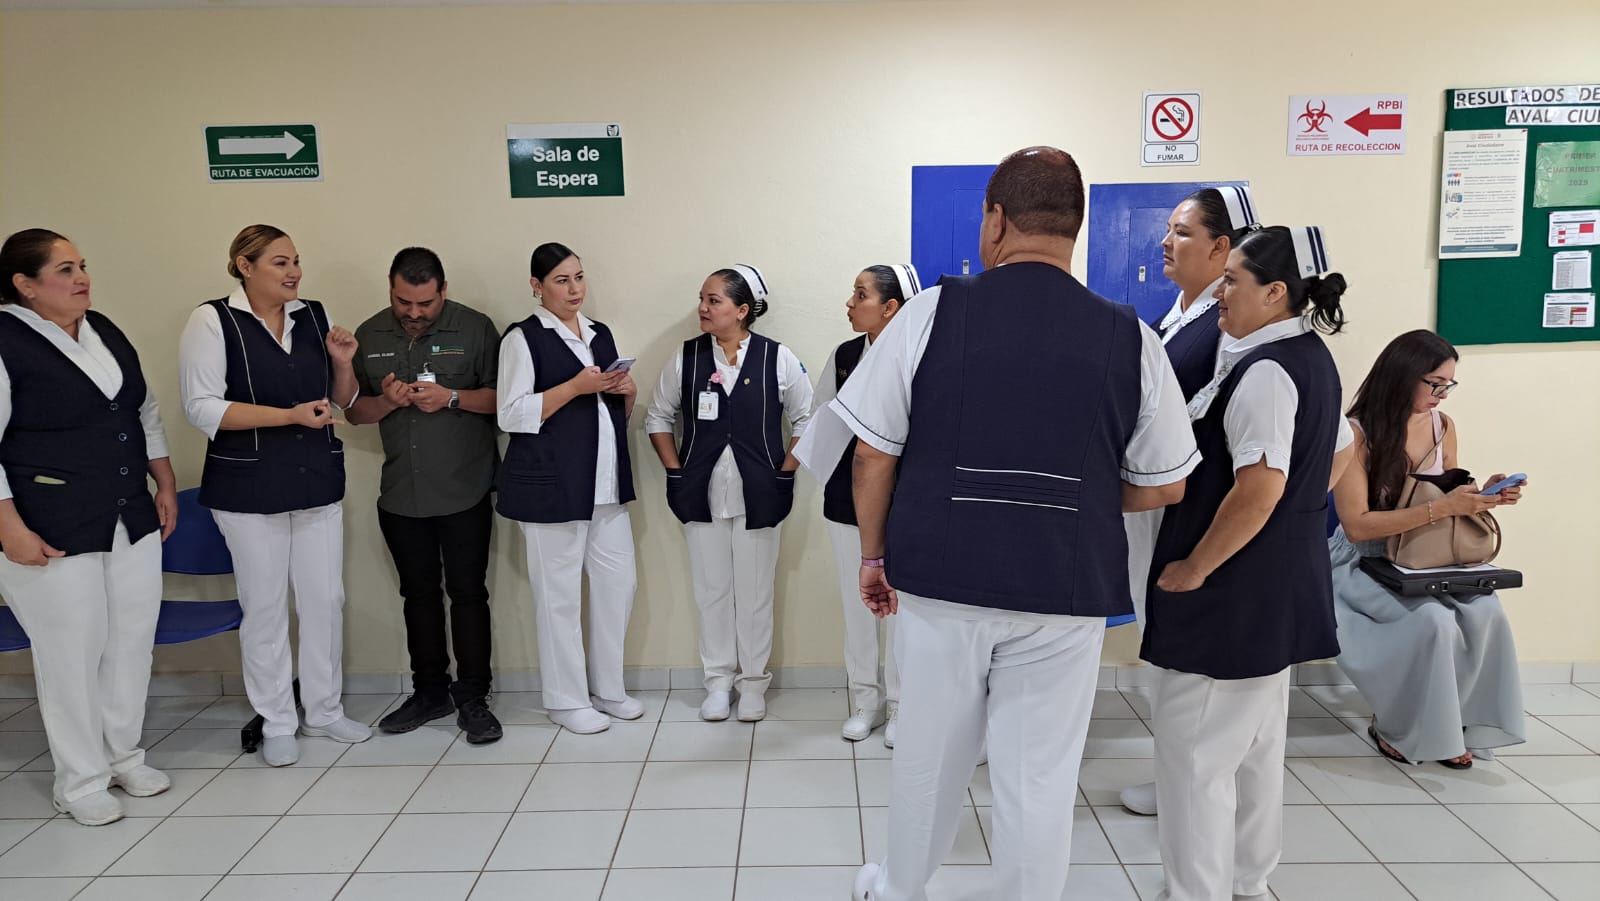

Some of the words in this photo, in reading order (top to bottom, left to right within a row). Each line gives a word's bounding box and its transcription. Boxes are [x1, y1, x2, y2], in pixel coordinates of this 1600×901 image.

[1456, 87, 1565, 107] RESULTADOS
[1377, 100, 1402, 110] RPBI
[1507, 109, 1552, 123] AVAL
[1567, 109, 1600, 123] CIU
[532, 145, 572, 162] Sala
[576, 145, 600, 161] de
[1295, 144, 1319, 152] RUTA
[1321, 143, 1334, 151] DE
[1335, 143, 1401, 151] RECOLECCION
[1157, 153, 1184, 161] FUMAR
[211, 169, 237, 178] RUTA
[239, 168, 253, 177] DE
[255, 166, 318, 177] EVACUACIÓN
[536, 170, 599, 189] Espera
